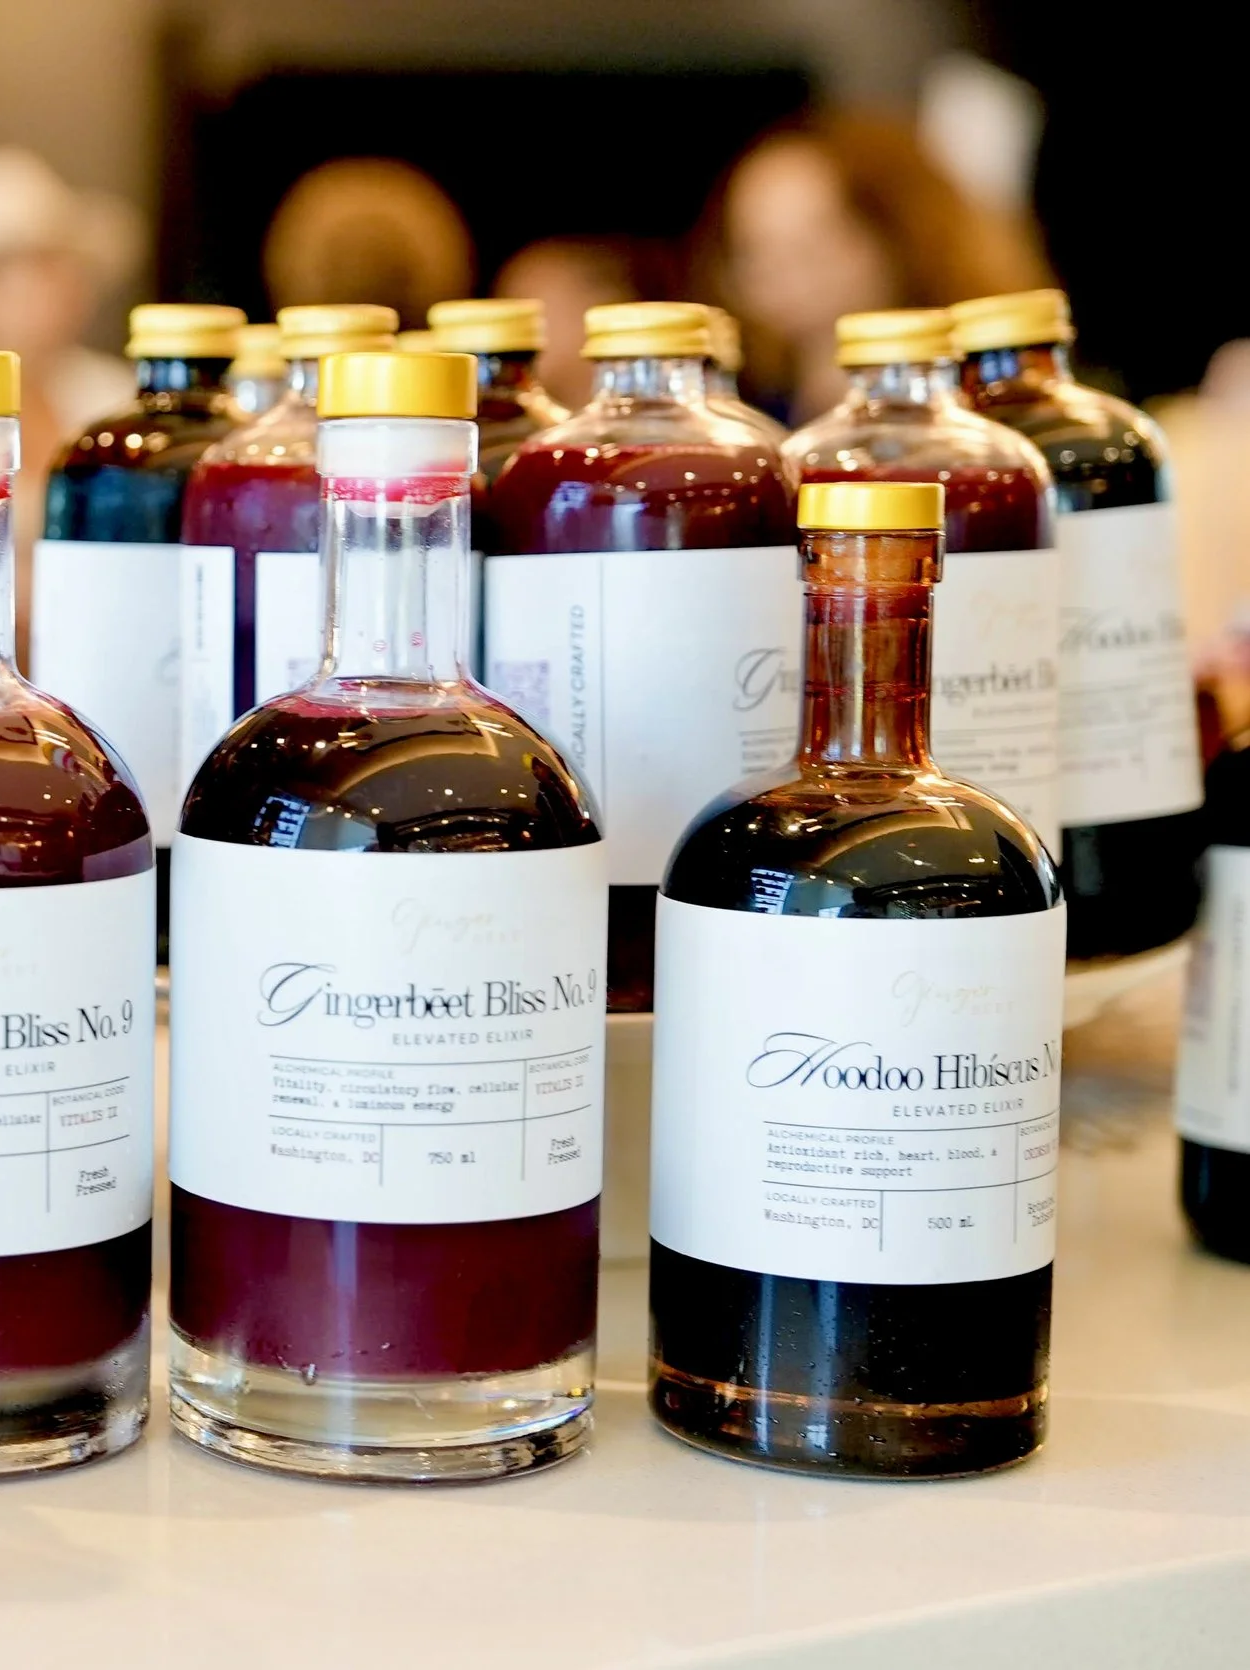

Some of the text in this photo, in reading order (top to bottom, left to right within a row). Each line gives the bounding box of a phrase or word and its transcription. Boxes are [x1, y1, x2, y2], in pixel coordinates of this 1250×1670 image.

[570, 604, 586, 768] CALLY CRAFTED
[483, 979, 547, 1018] Bliss
[552, 972, 585, 1012] No.
[588, 967, 598, 1003] 9
[1, 1013, 71, 1052] Bliss
[76, 1004, 117, 1044] No.
[121, 998, 134, 1036] 9
[392, 1028, 533, 1047] ELEVATED ELIXIR
[5, 1060, 57, 1077] ELIXIR
[746, 1031, 925, 1092] Hoodoo
[339, 1081, 420, 1098] circulatory
[469, 1081, 520, 1095] cellular
[348, 1099, 406, 1111] luminous
[412, 1101, 455, 1113] energy
[892, 1097, 1025, 1118] ELEVATED ELIXIR
[271, 1126, 319, 1139] LOCALLY
[766, 1128, 896, 1146] ALCHEMICAL PROFILE
[270, 1143, 380, 1164] Washington, DC
[427, 1152, 453, 1165] 750
[766, 1142, 847, 1160] Antioxidant
[853, 1149, 890, 1162] rich,
[897, 1149, 941, 1163] heart,
[947, 1146, 985, 1160] blood,
[766, 1158, 913, 1179] reproductive support
[765, 1191, 877, 1209] LOCALLY CRAFTED
[763, 1208, 879, 1230] Washington, DC
[927, 1215, 976, 1230] 500 mL
